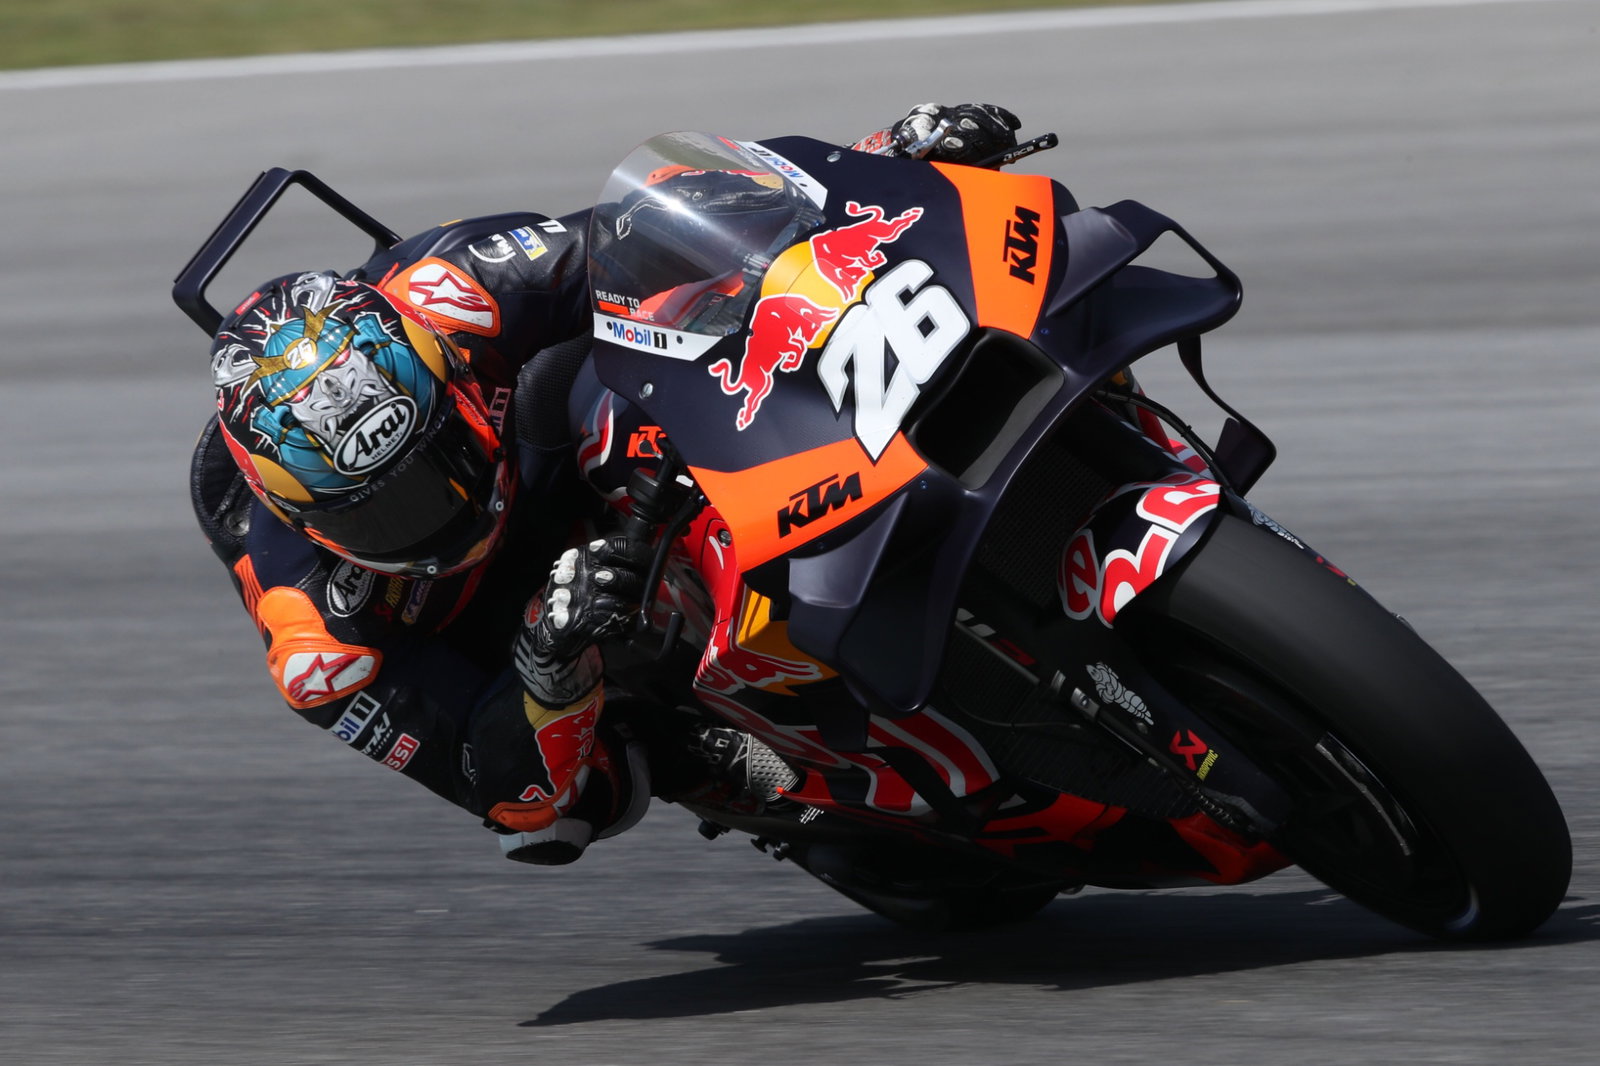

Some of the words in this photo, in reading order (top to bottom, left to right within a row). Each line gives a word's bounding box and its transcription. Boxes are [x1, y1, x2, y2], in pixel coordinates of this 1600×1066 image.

[1003, 205, 1041, 285] KTM
[595, 290, 625, 305] READY
[626, 297, 641, 308] TO
[629, 308, 655, 321] RACE
[613, 322, 652, 346] Mobil
[655, 332, 666, 349] 1
[286, 338, 318, 370] 26
[817, 259, 971, 461] 26
[347, 402, 406, 470] Arai
[371, 432, 402, 460] HELMET
[777, 472, 863, 538] KTM
[333, 564, 363, 613] Ara
[386, 740, 414, 769] SSI
